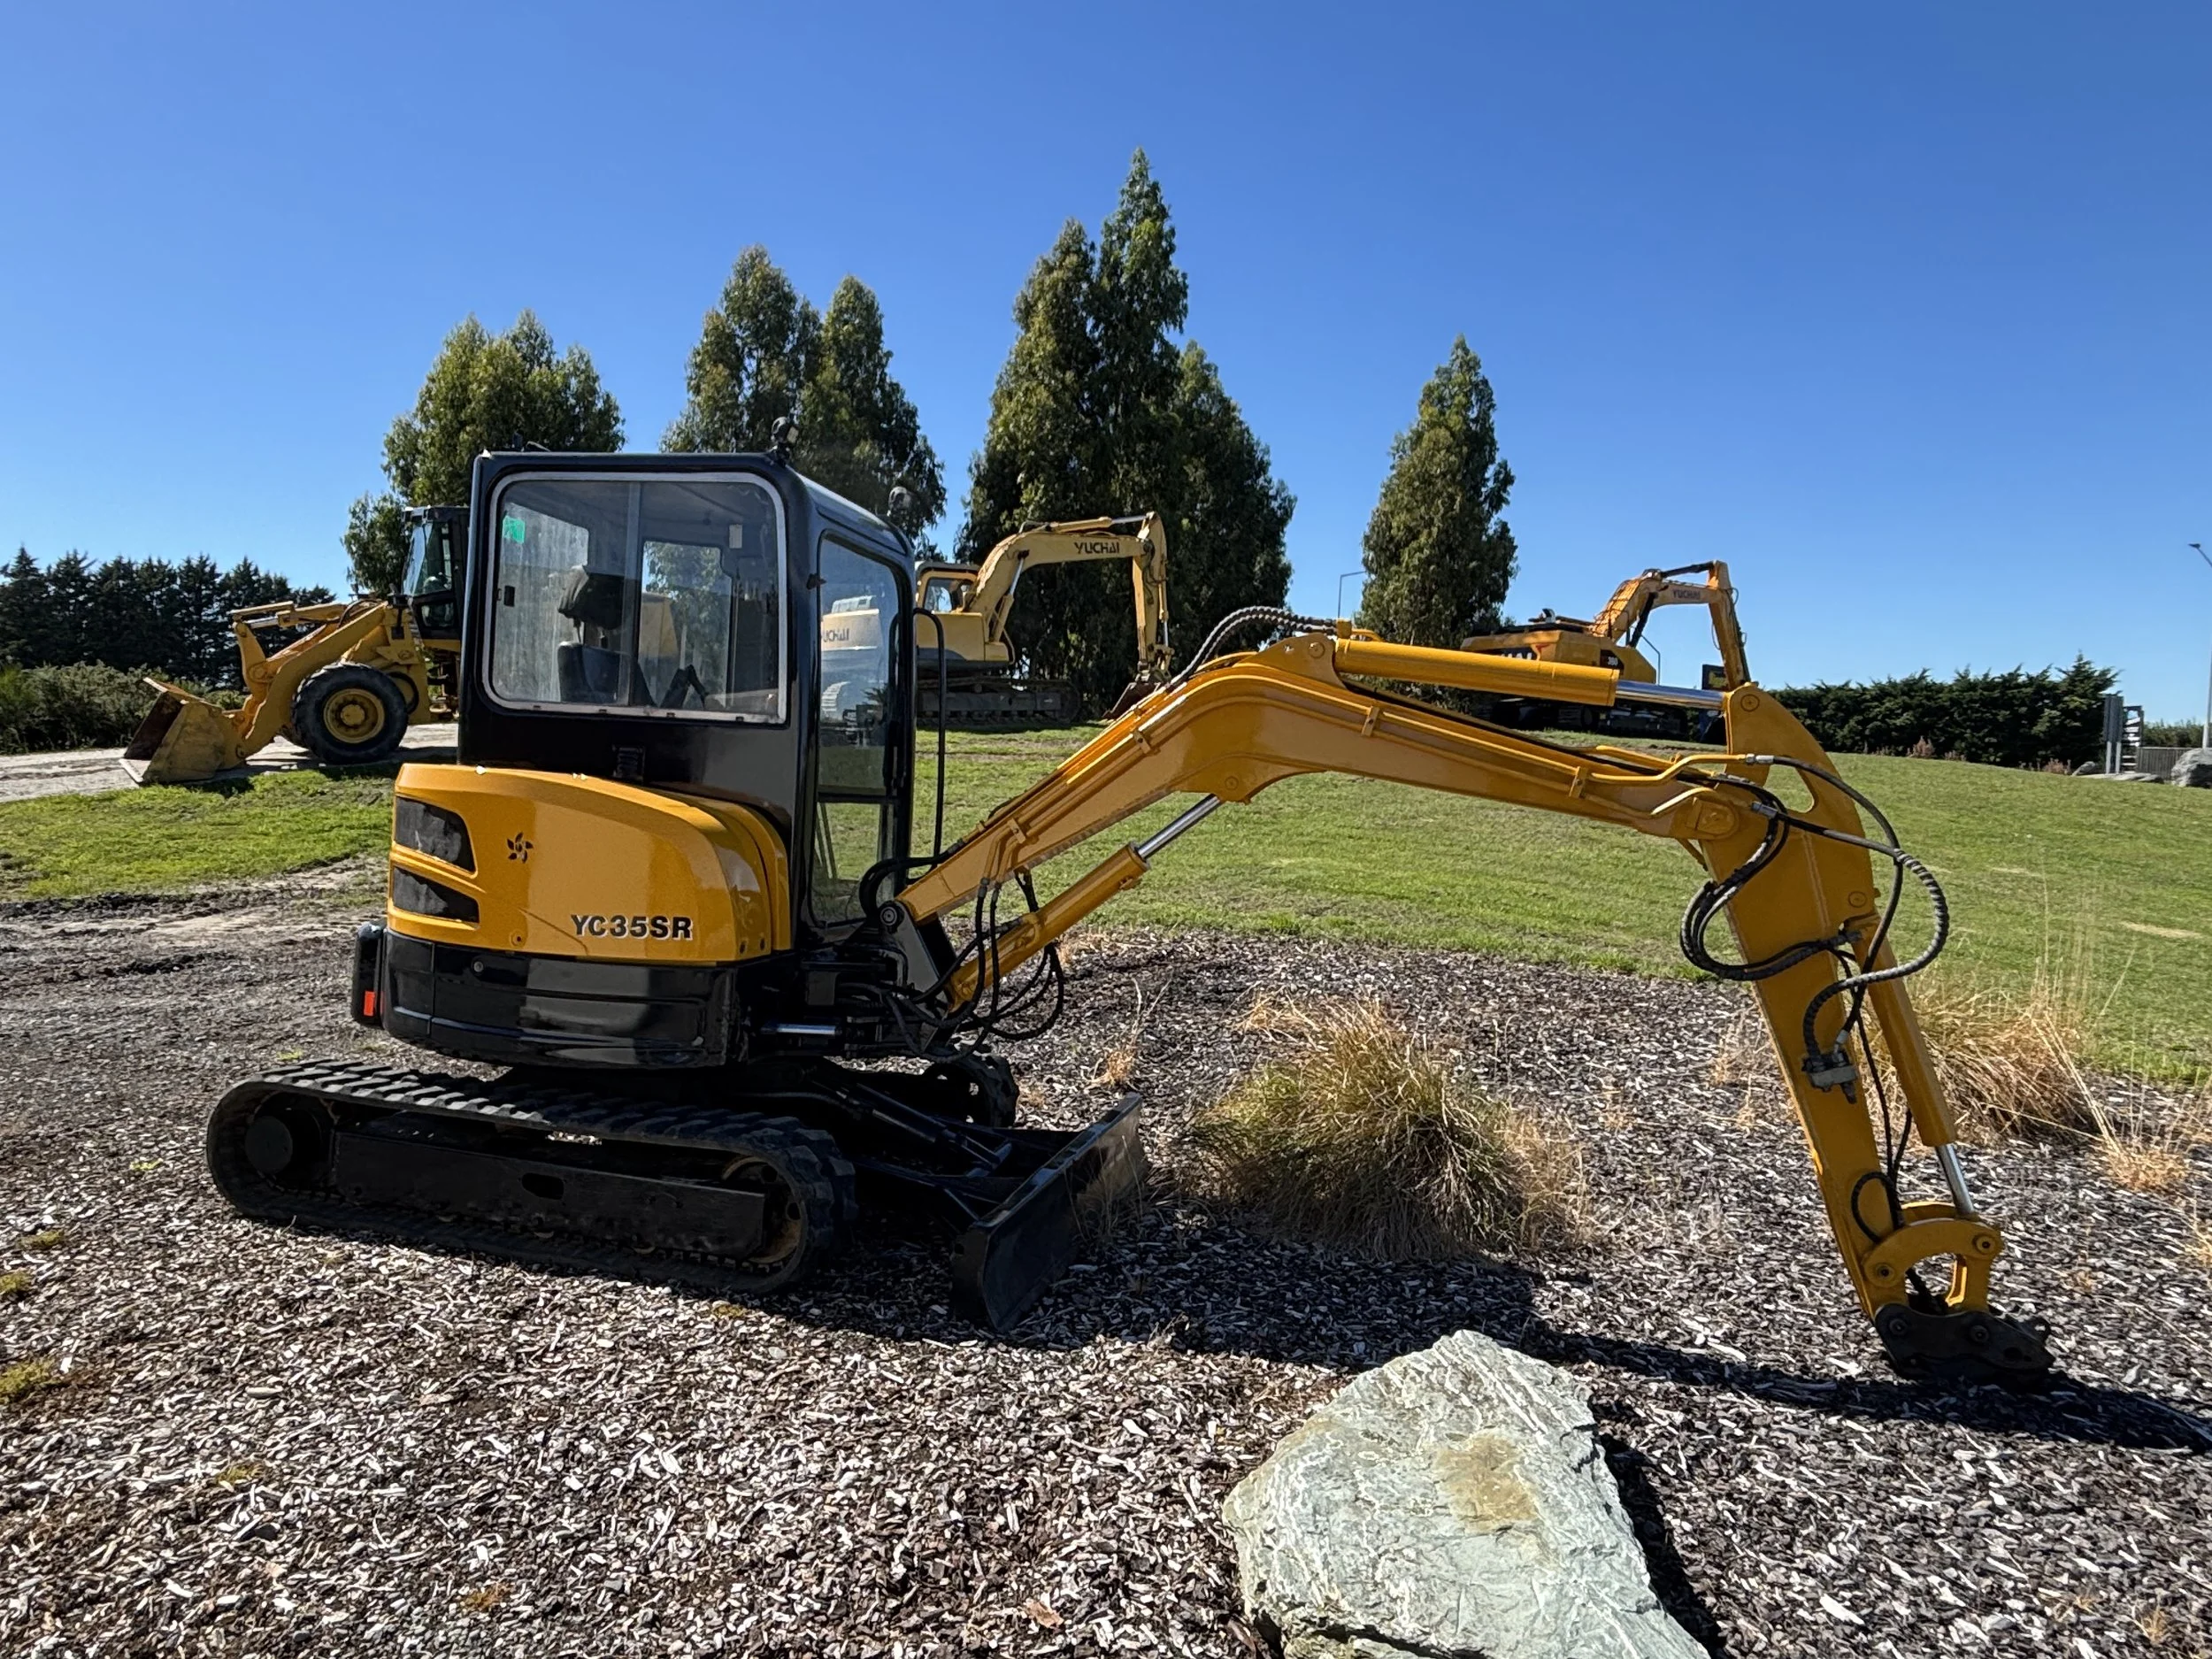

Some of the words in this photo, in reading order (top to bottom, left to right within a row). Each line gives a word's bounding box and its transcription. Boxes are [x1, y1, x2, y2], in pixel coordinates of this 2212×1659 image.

[1074, 541, 1120, 554] YUCHAI
[823, 628, 849, 642] UCHAI
[571, 914, 694, 941] YC35SR
